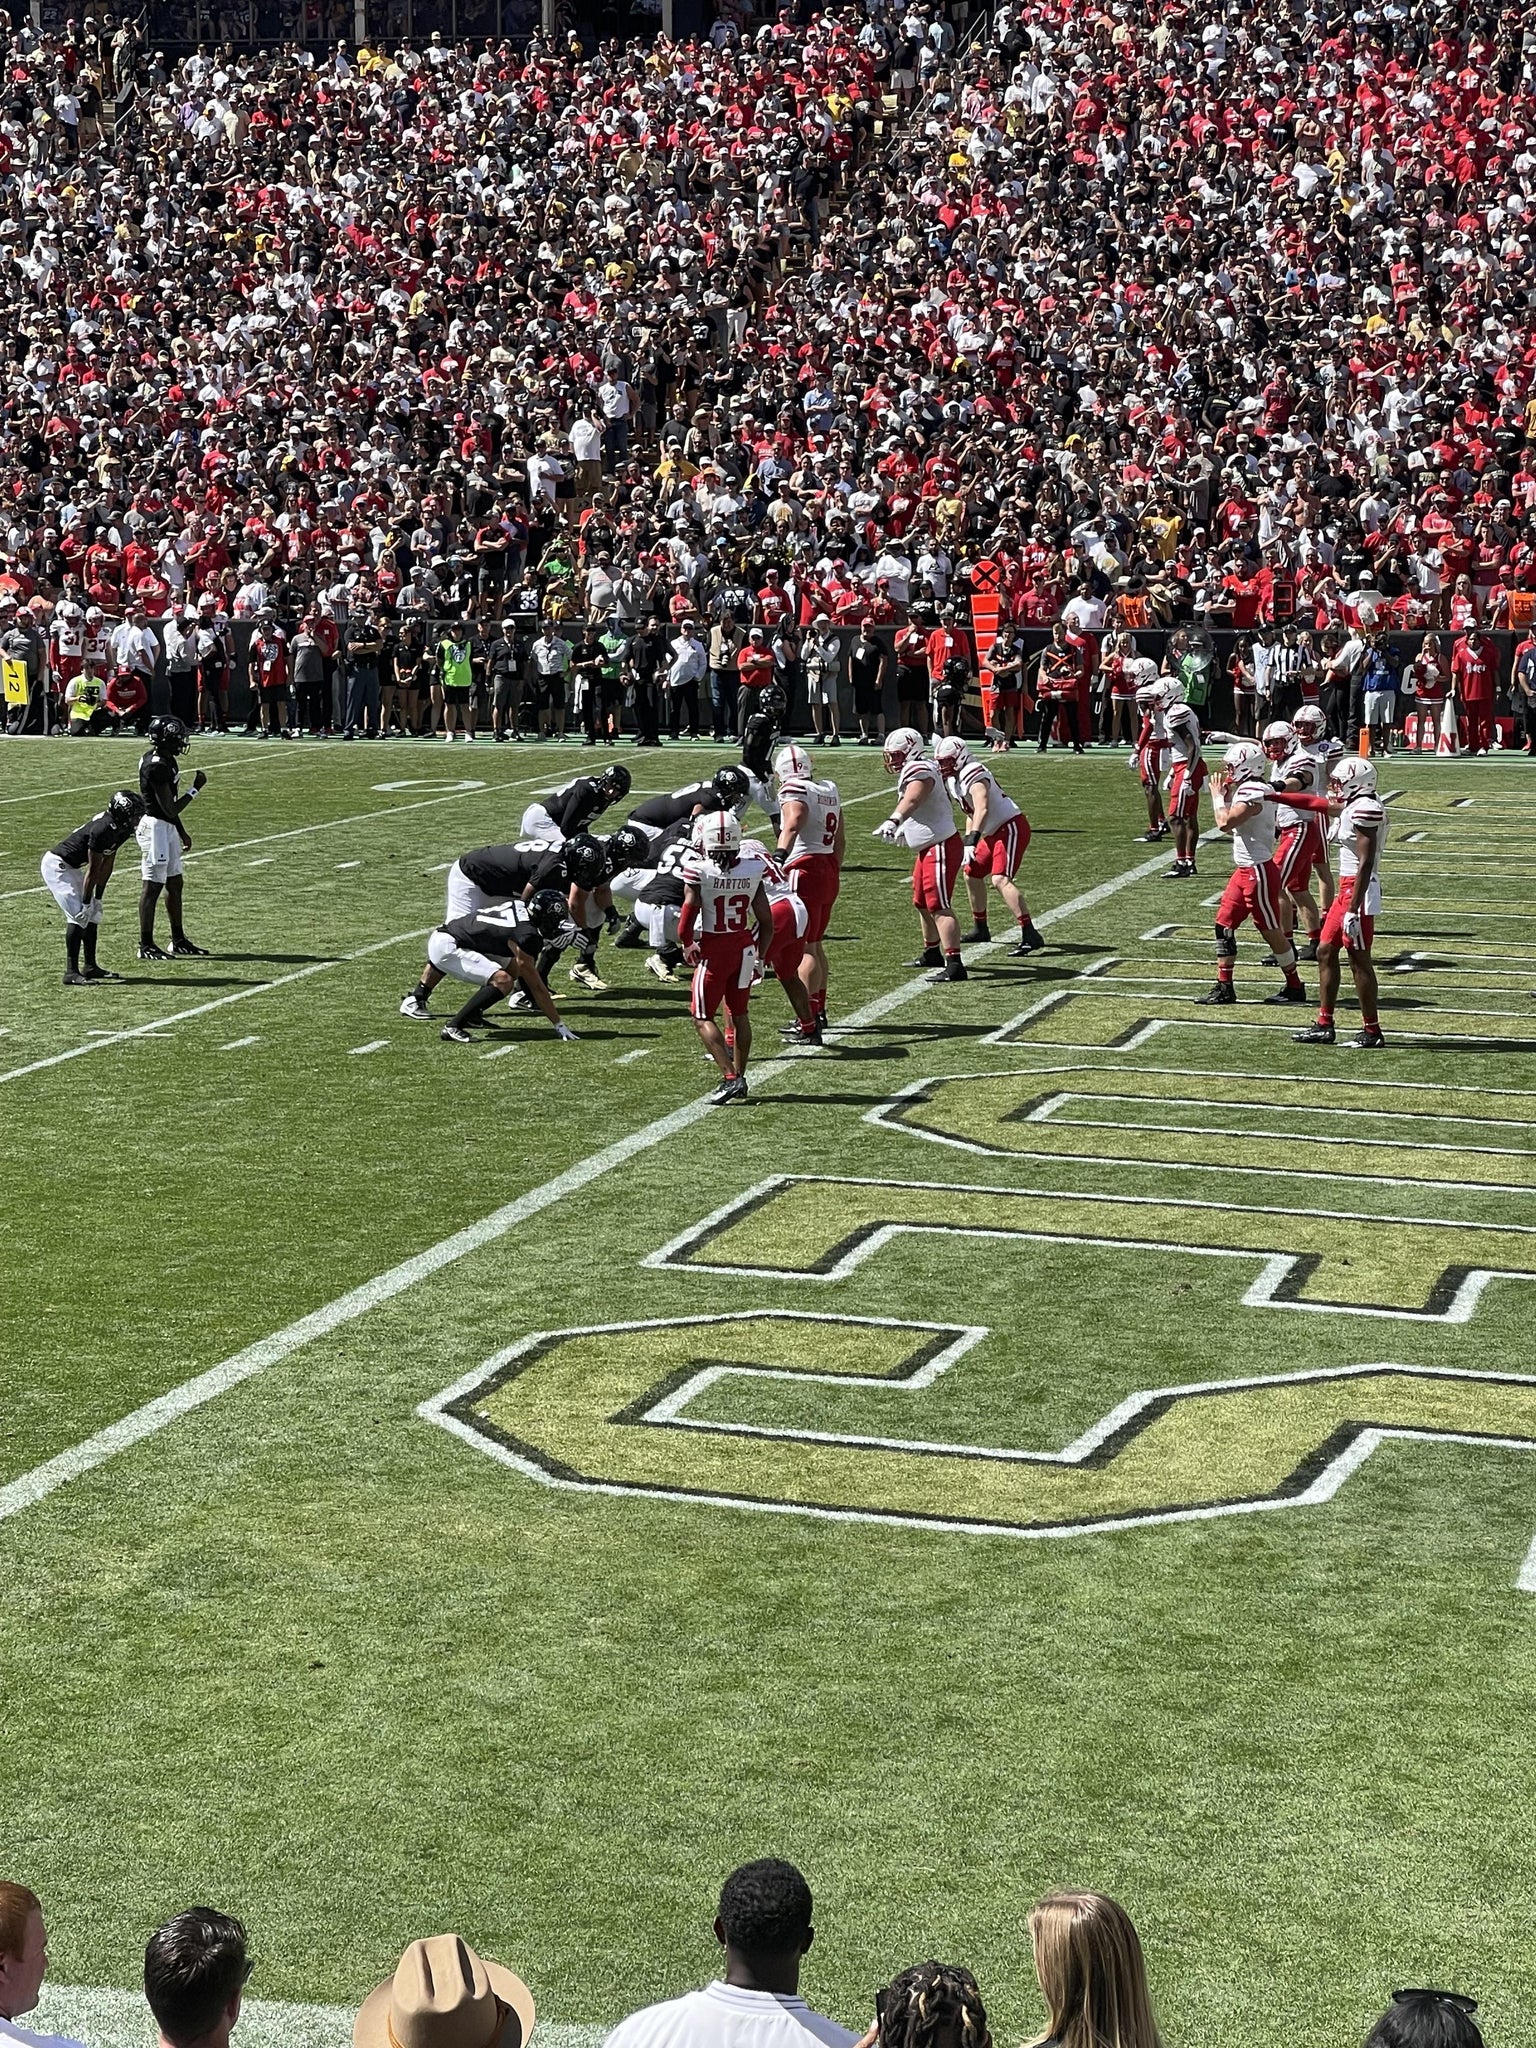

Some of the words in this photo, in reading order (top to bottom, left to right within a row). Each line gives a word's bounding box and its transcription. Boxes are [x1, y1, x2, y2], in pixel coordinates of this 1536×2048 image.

[87, 639, 107, 653] 37
[8, 671, 20, 693] 12
[1439, 732, 1457, 753] N
[822, 812, 838, 847] 9
[713, 877, 751, 889] HARTZOG
[713, 894, 751, 933] 13
